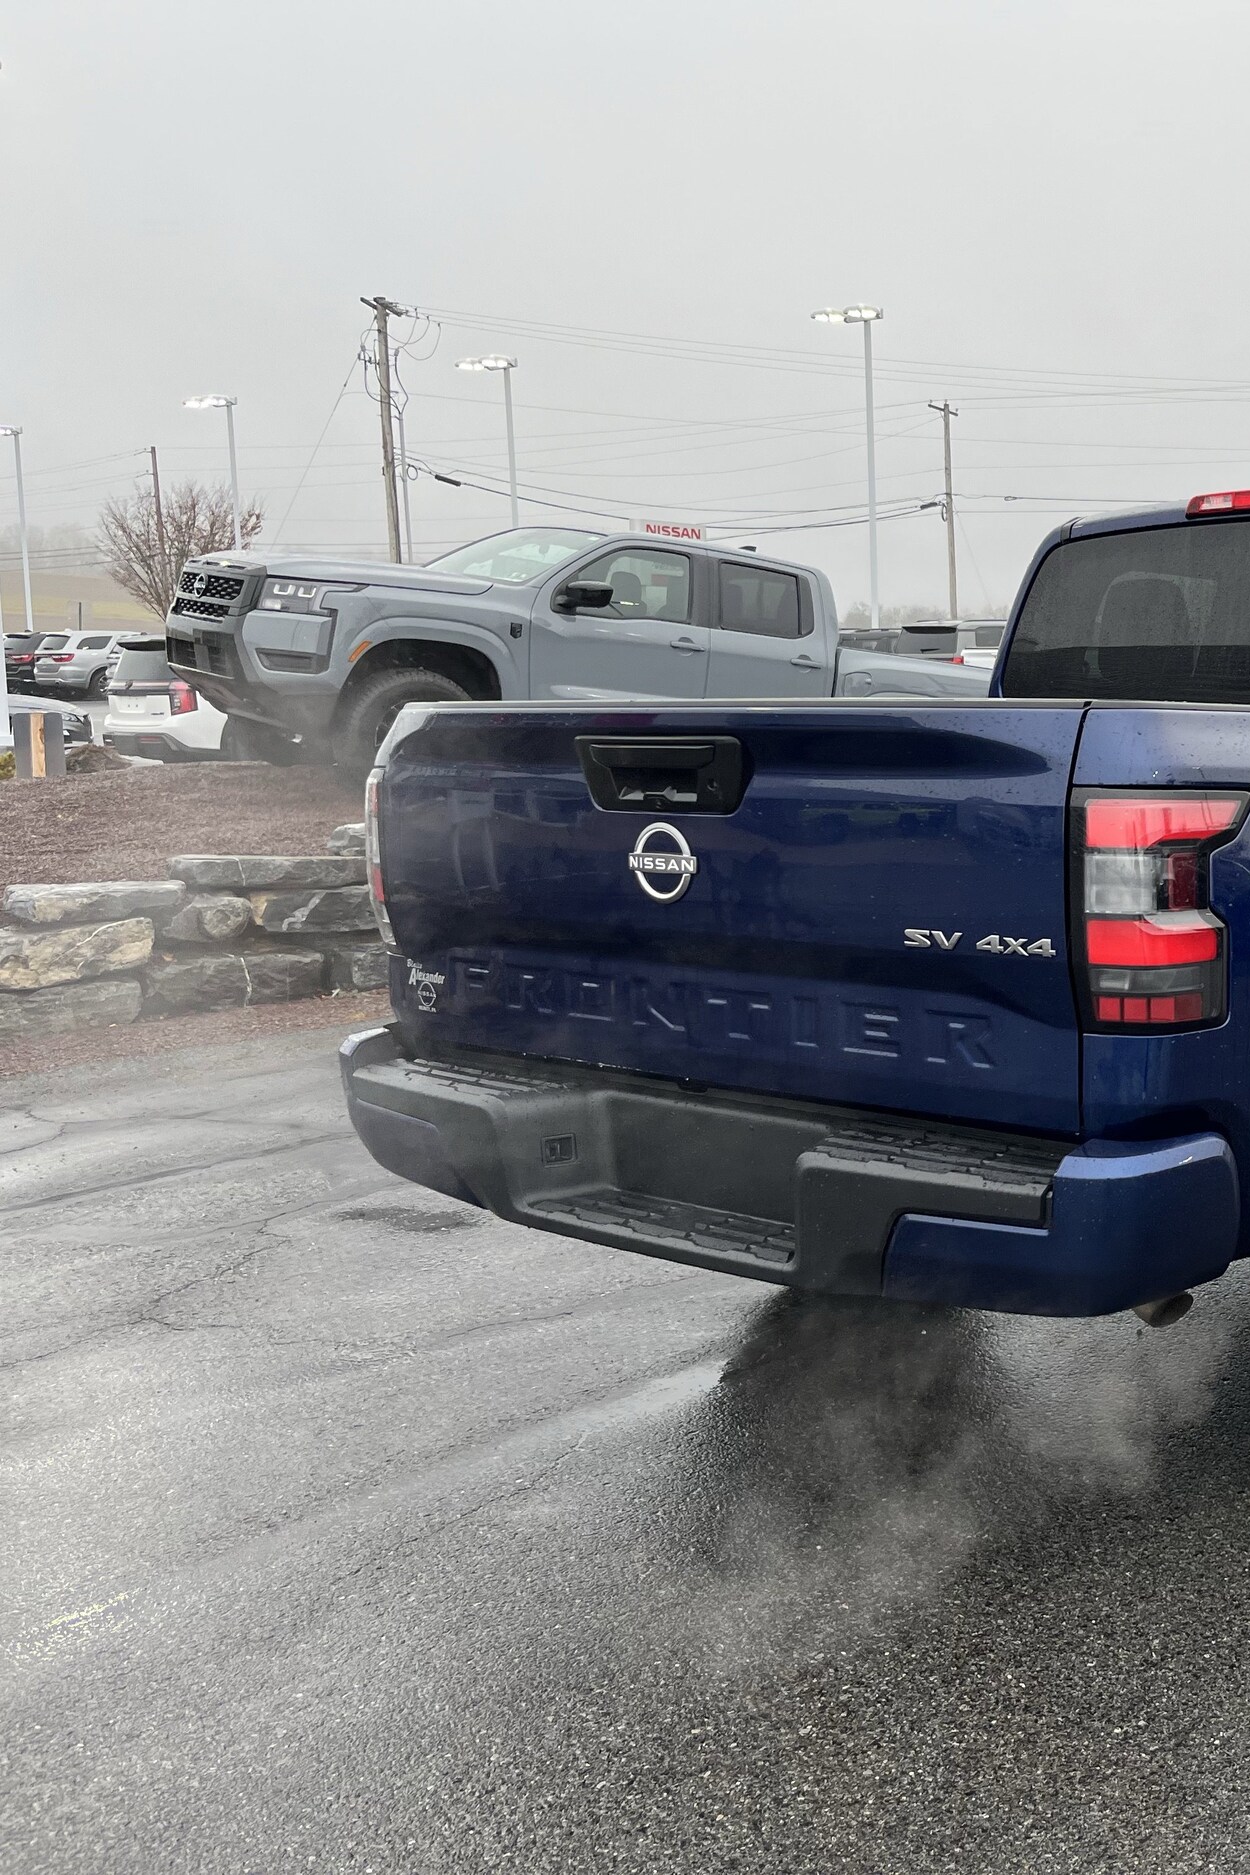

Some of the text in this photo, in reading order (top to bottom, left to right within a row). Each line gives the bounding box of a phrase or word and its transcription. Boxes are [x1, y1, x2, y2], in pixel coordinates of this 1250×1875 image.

[646, 524, 700, 539] NISSAN
[629, 855, 694, 872] NISSAN
[903, 928, 963, 950] SV
[409, 968, 445, 985] Alexander
[449, 956, 995, 1069] FRONTIER
